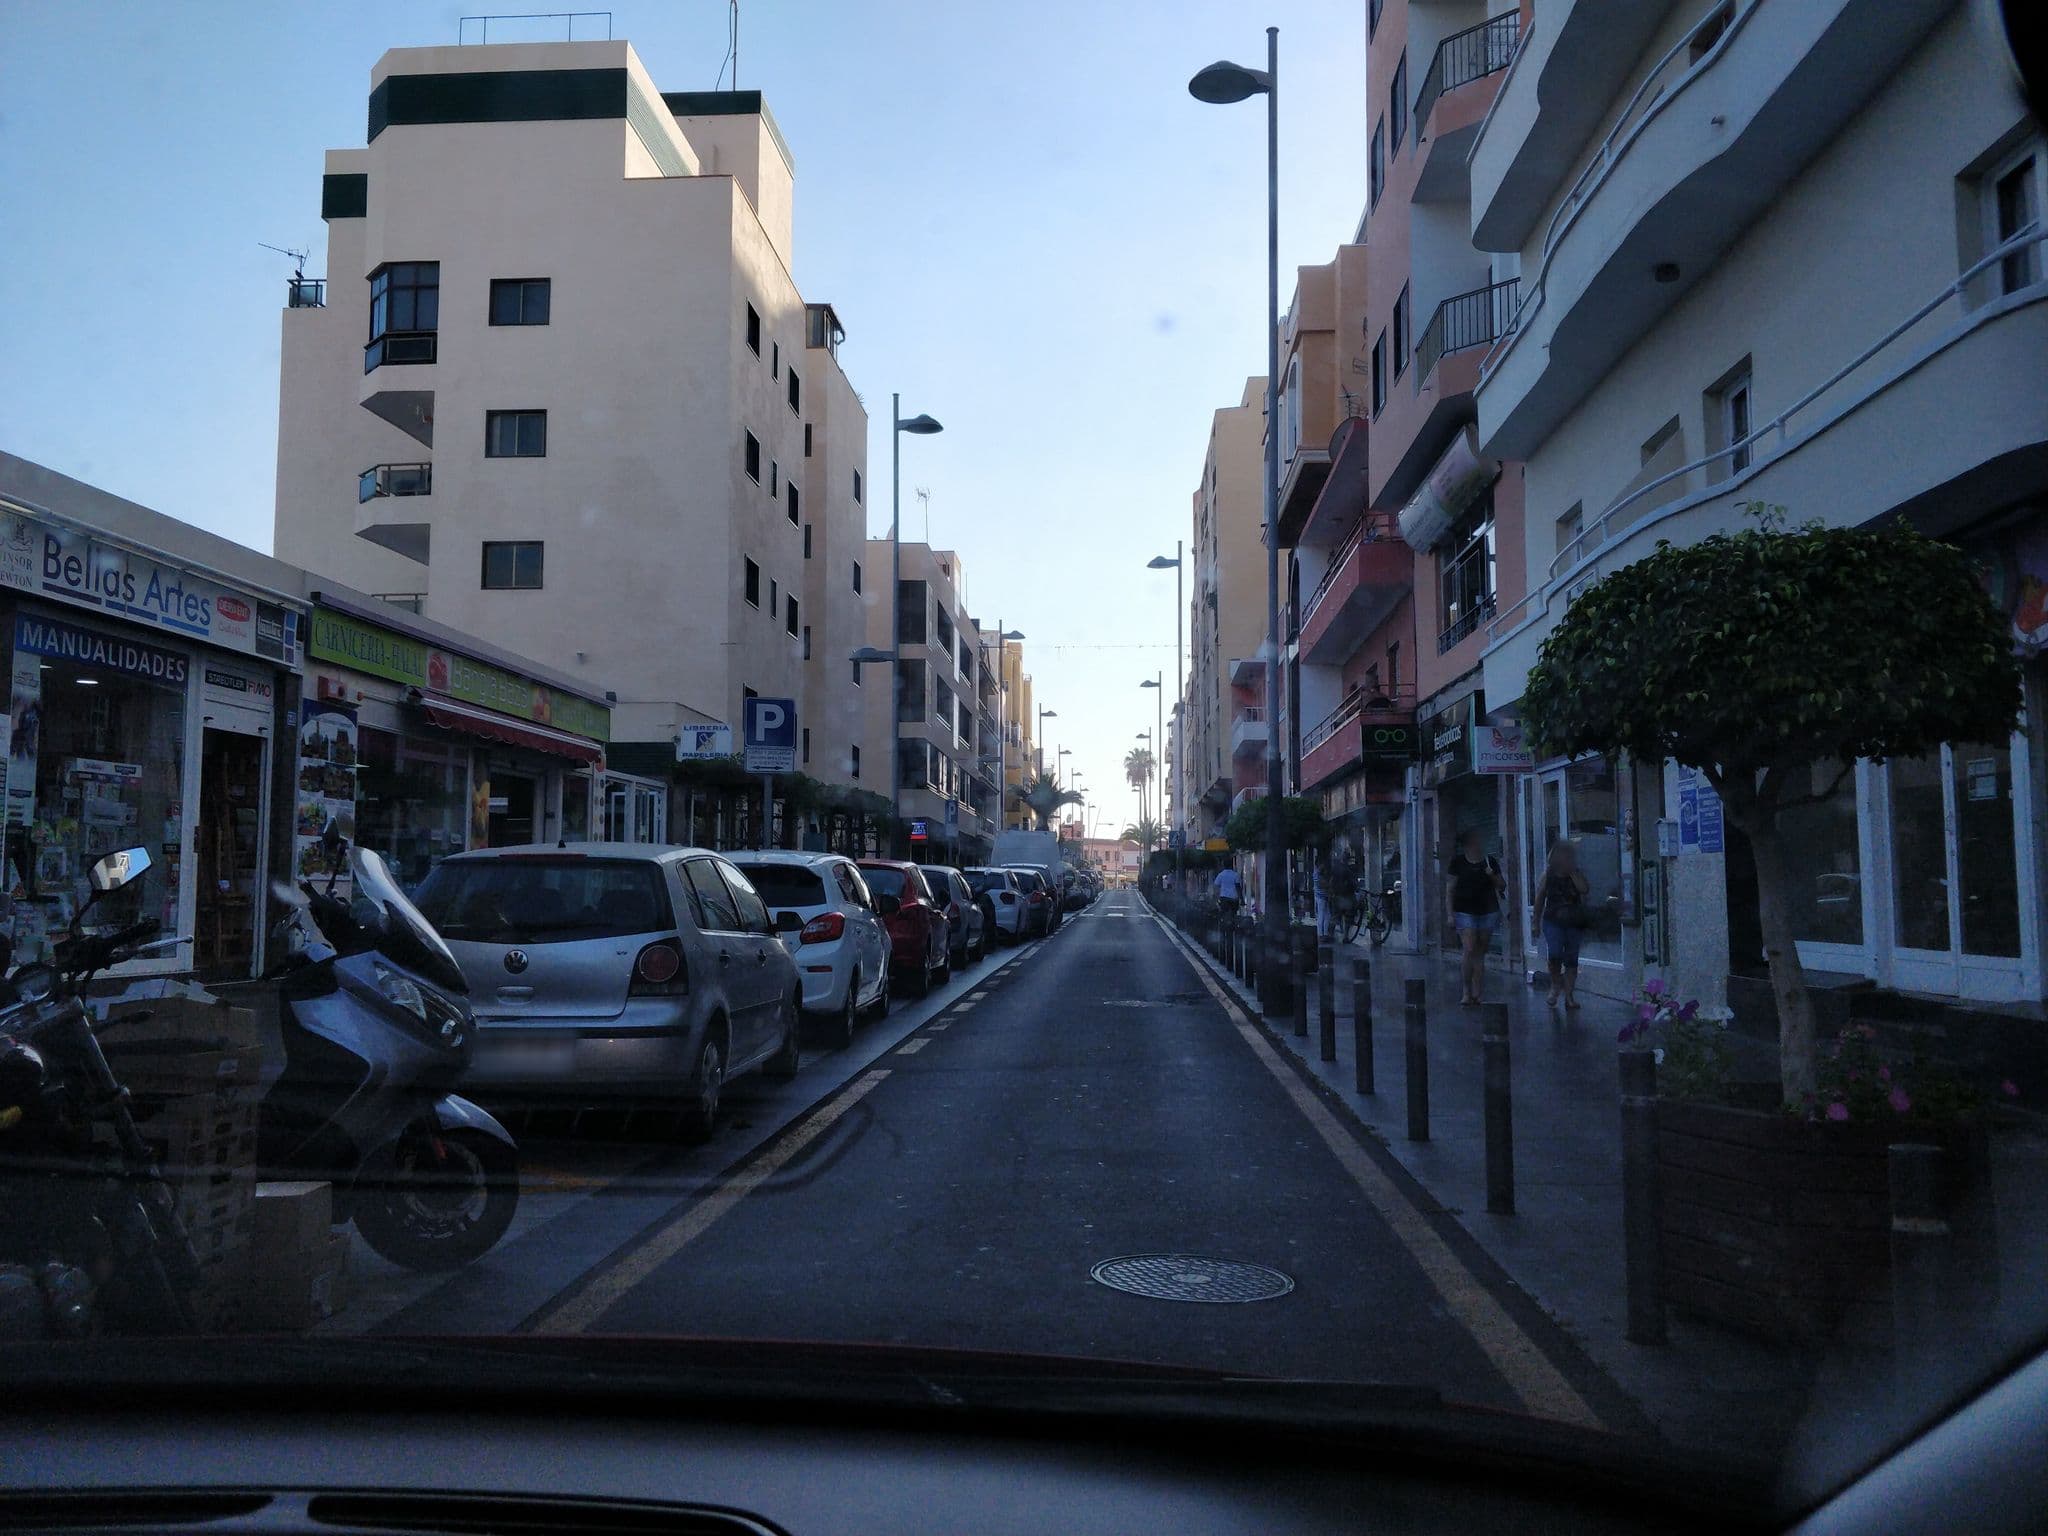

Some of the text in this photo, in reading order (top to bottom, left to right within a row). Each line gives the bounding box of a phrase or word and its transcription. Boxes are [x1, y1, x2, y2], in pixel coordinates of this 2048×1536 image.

[0, 550, 33, 571] INSOR
[0, 570, 33, 587] EWTON
[43, 533, 212, 626] Bellas Artes
[22, 621, 186, 683] MANUALIDADES
[206, 672, 247, 690] STAEDTLER
[755, 703, 786, 742] P
